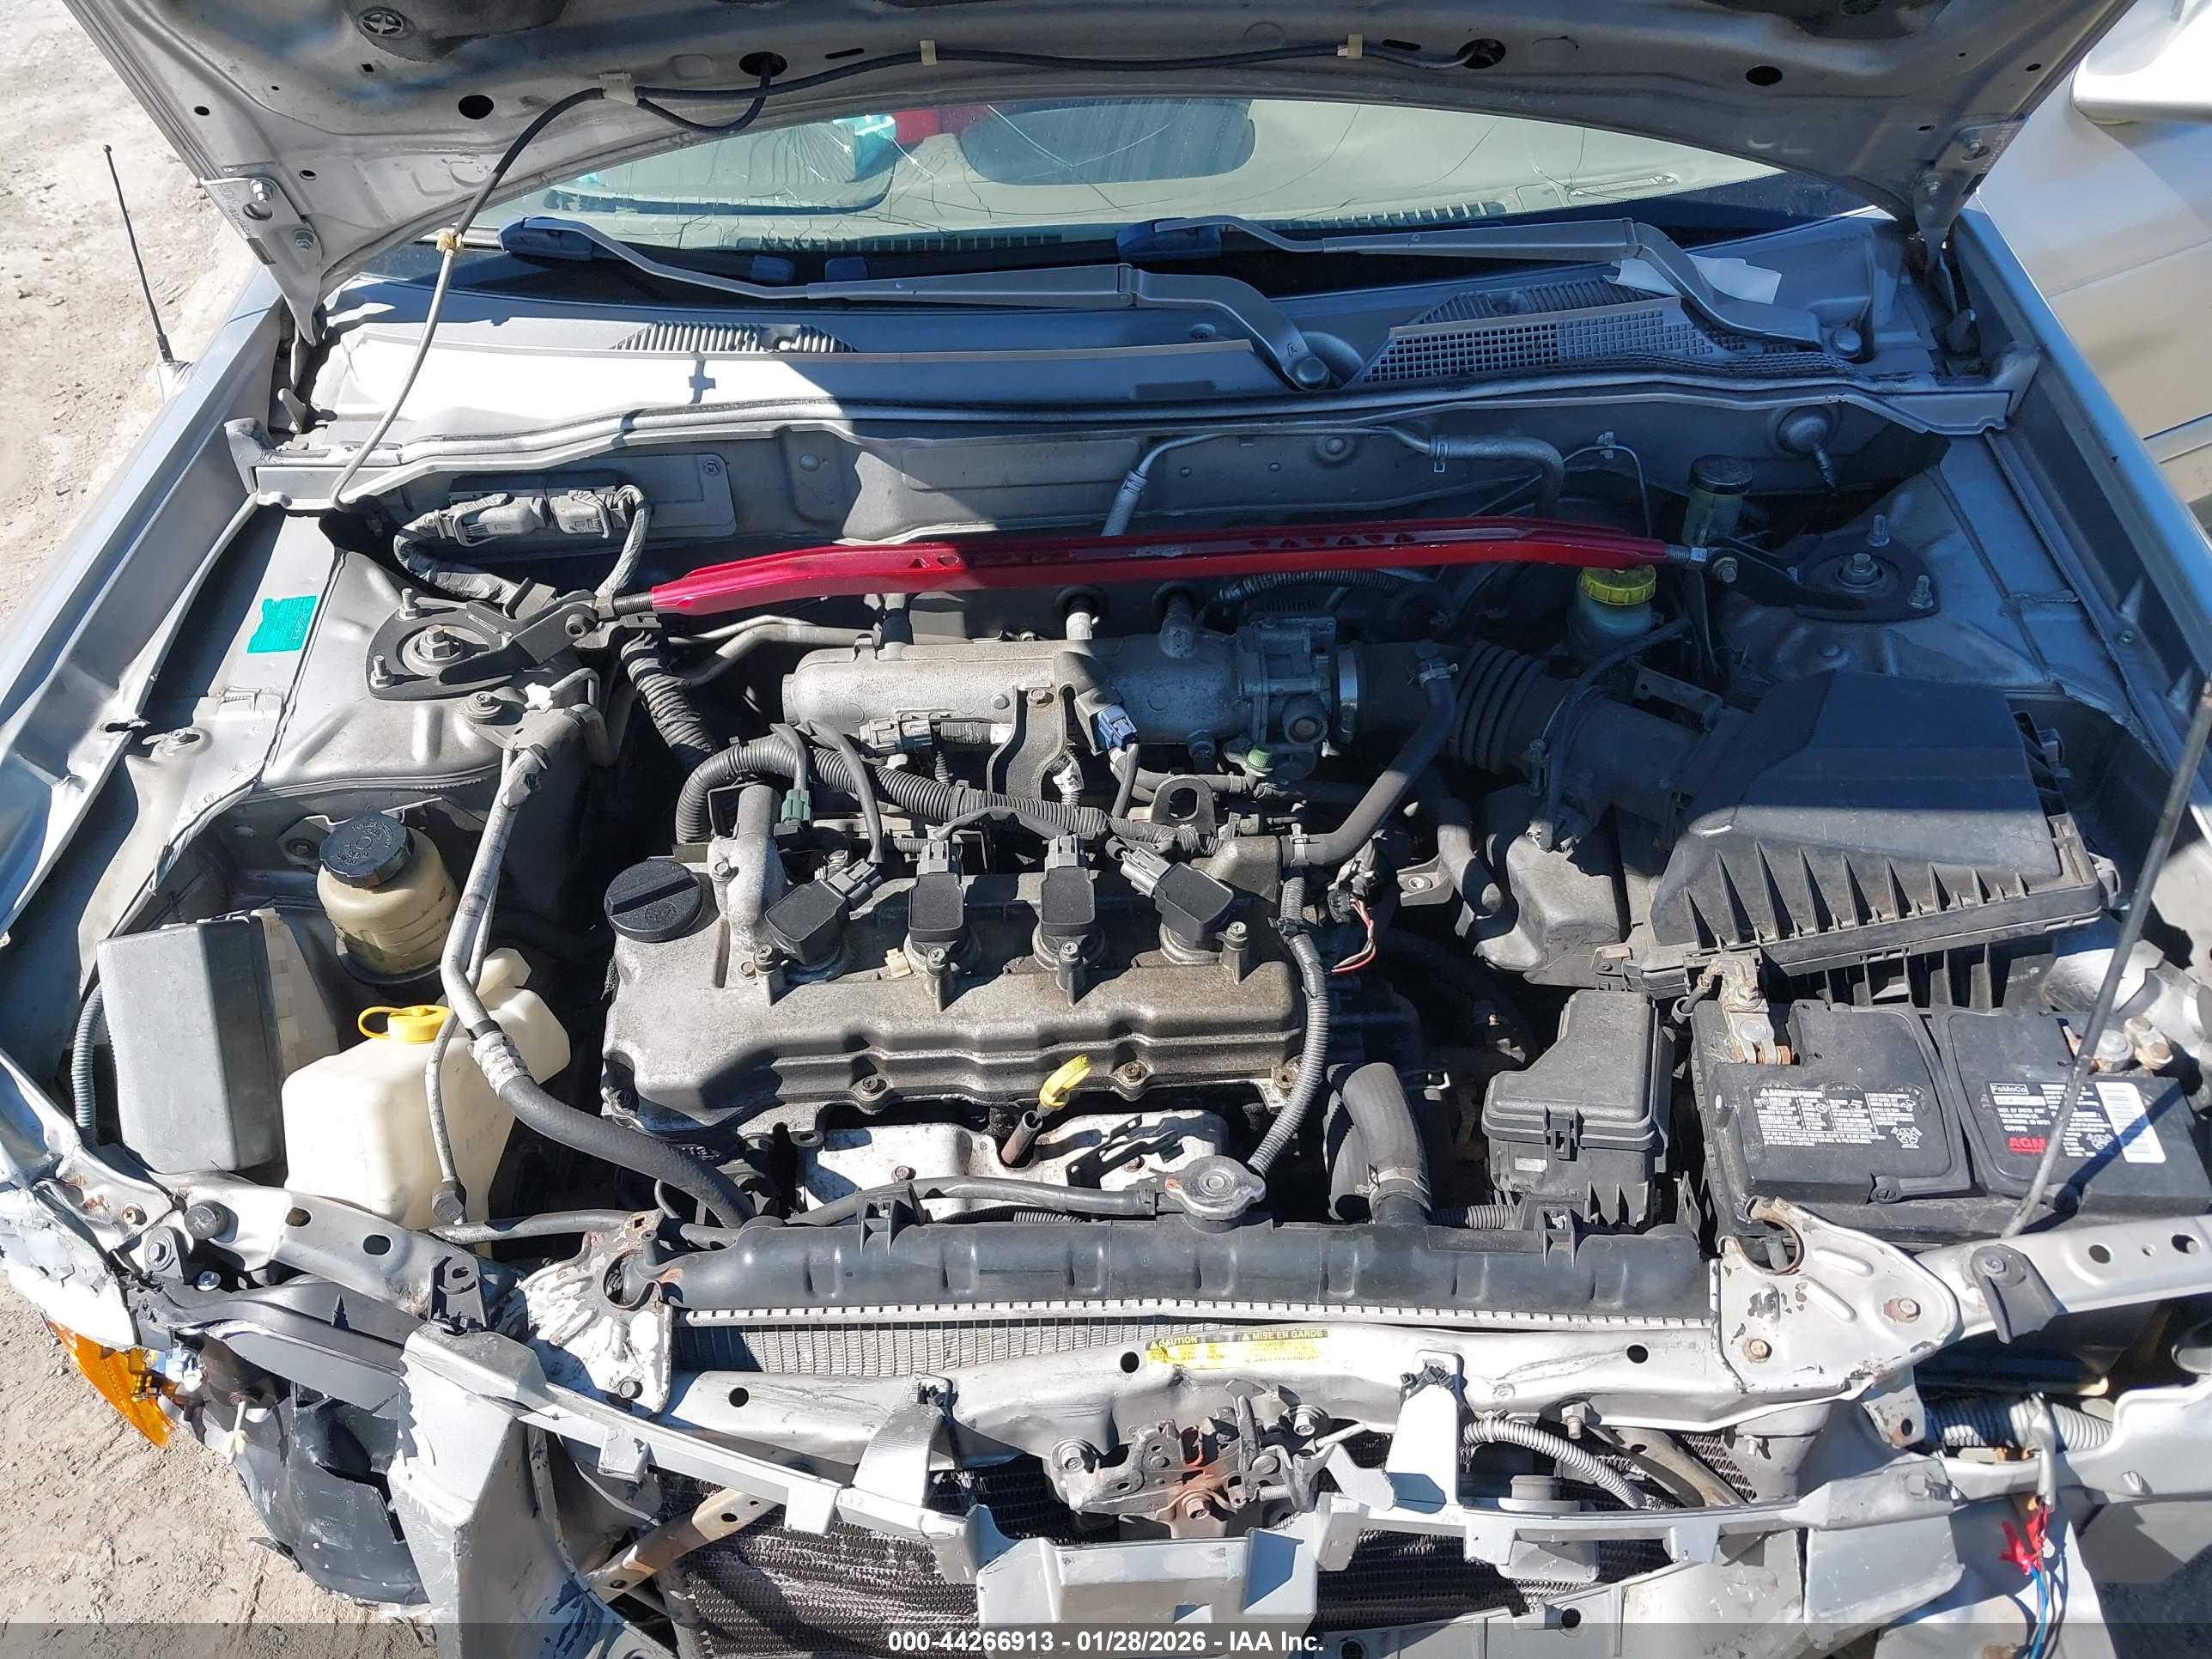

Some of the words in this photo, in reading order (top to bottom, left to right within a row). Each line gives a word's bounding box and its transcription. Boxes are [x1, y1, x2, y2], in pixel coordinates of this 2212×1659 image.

[1252, 1331, 1274, 1340] MISE
[1276, 1330, 1289, 1339] EN
[1291, 1329, 1323, 1339] GARDE
[1158, 1335, 1198, 1348] CAUTION
